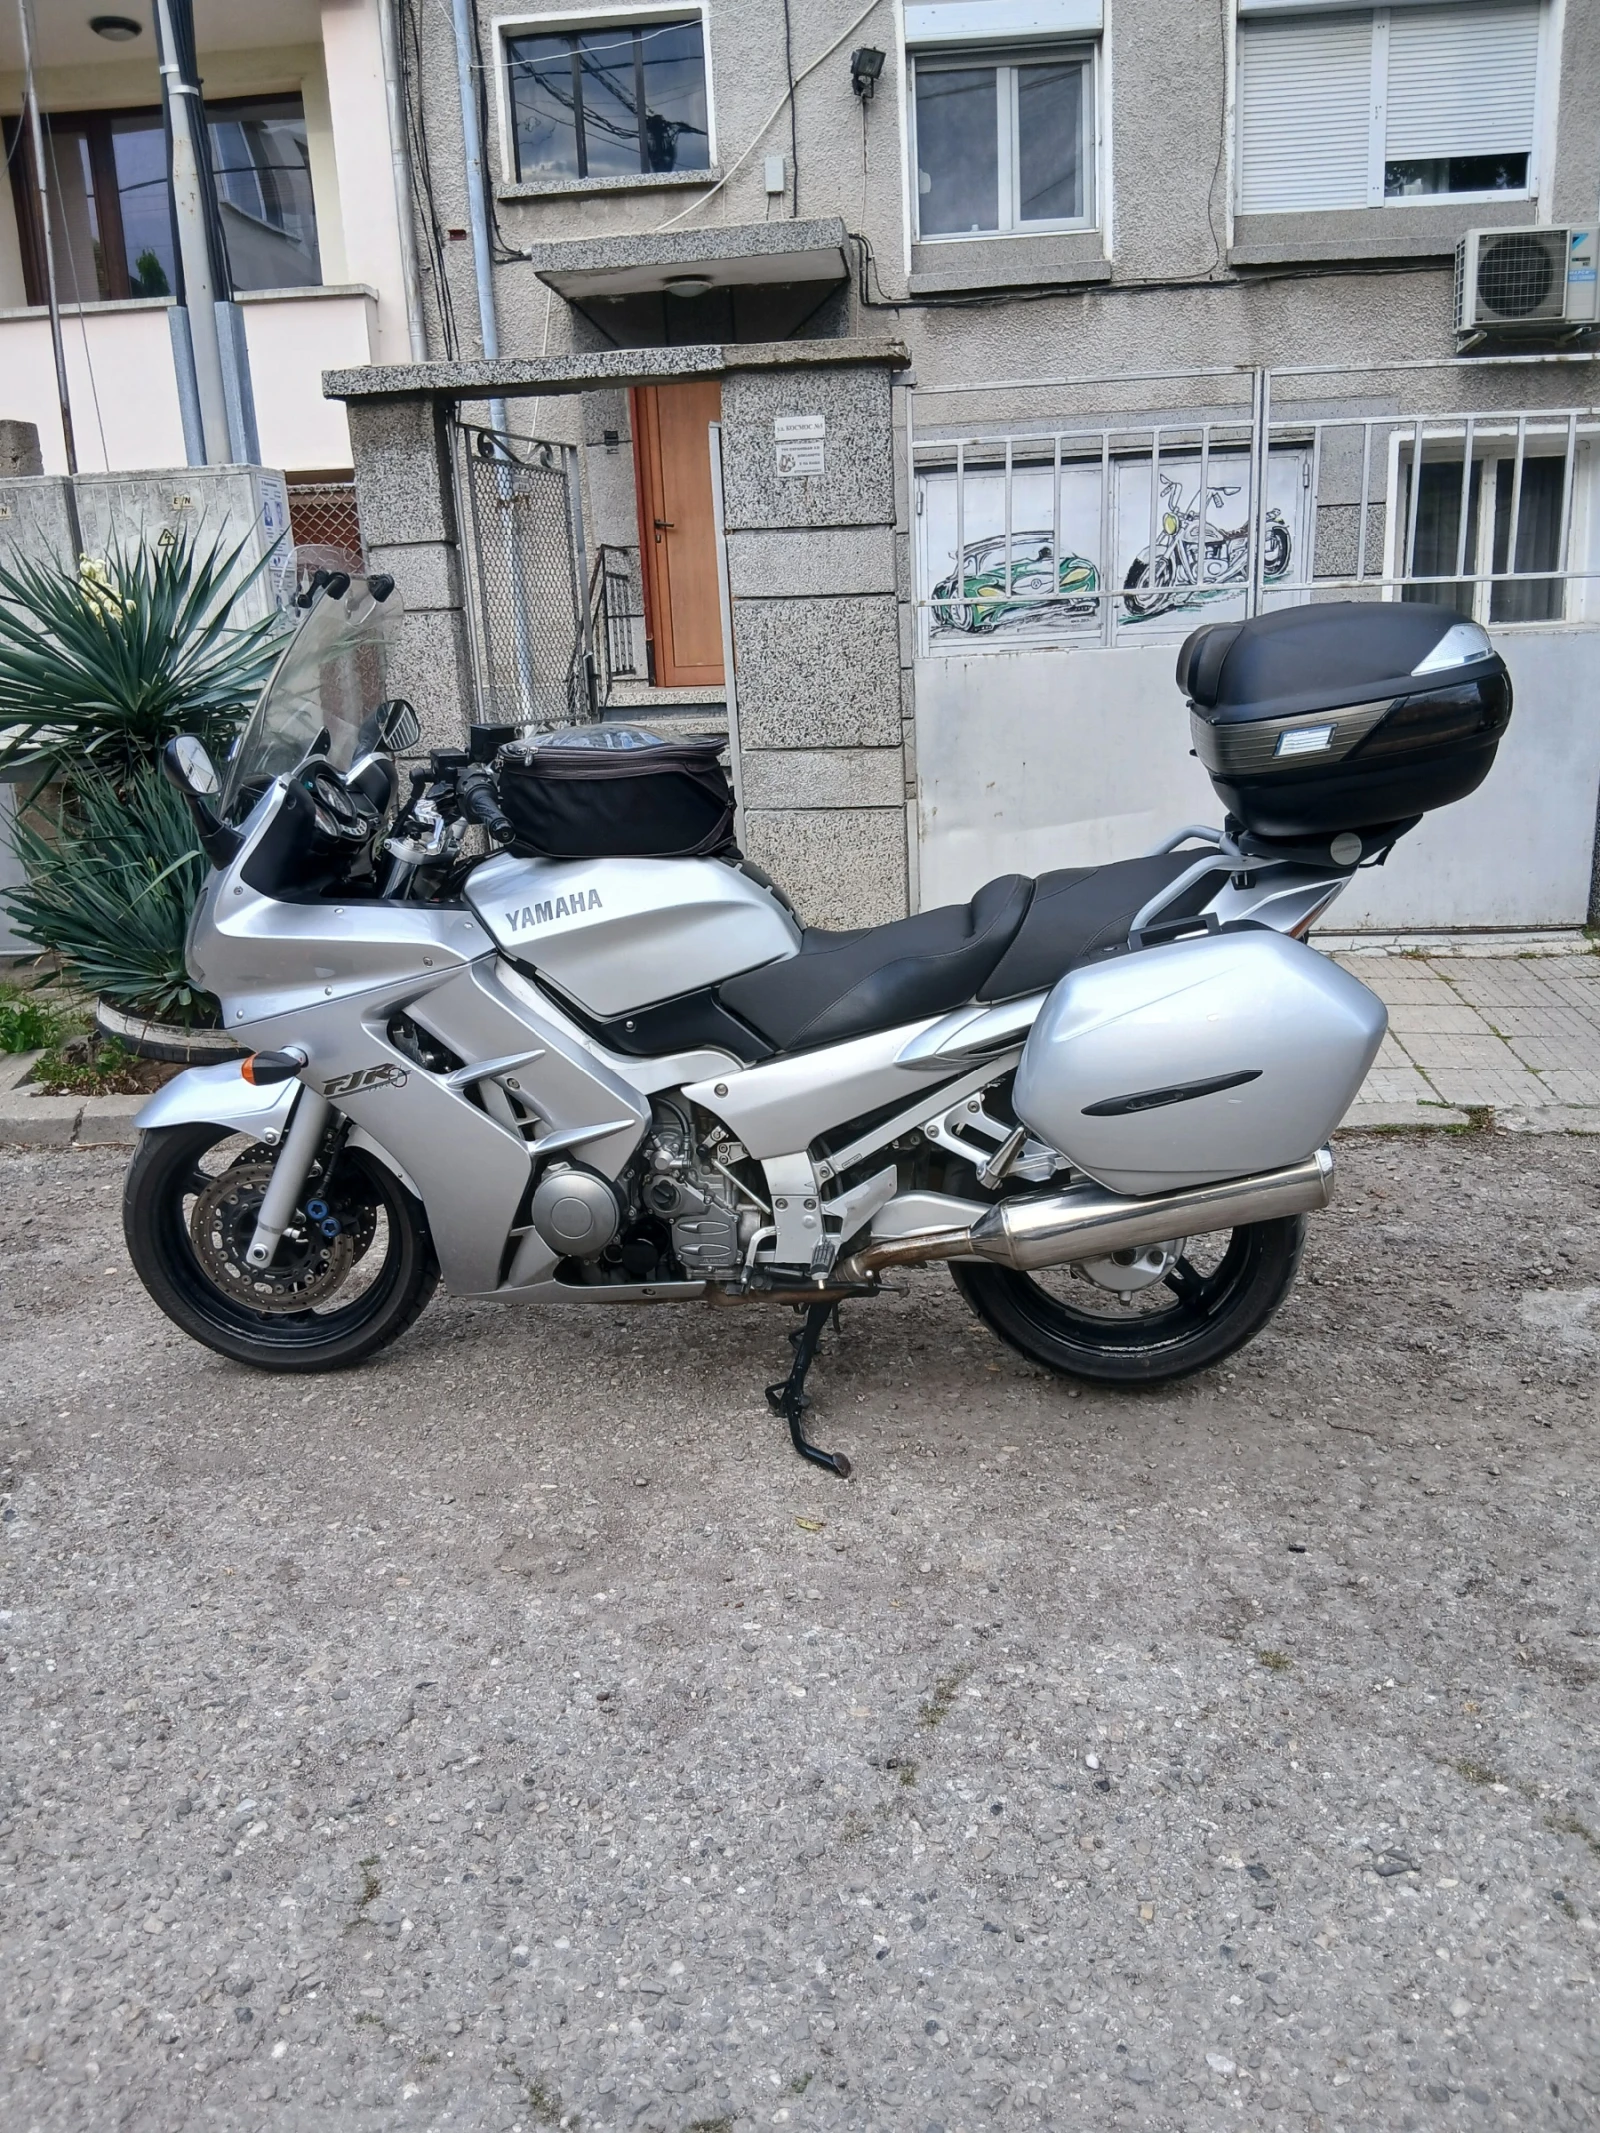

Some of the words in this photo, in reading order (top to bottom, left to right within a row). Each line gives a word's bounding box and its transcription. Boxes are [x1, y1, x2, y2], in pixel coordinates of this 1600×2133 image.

[786, 423, 813, 431] КОСМОС
[173, 497, 191, 505] EN
[505, 889, 603, 932] YAMAHA
[321, 1063, 397, 1096] FJR
